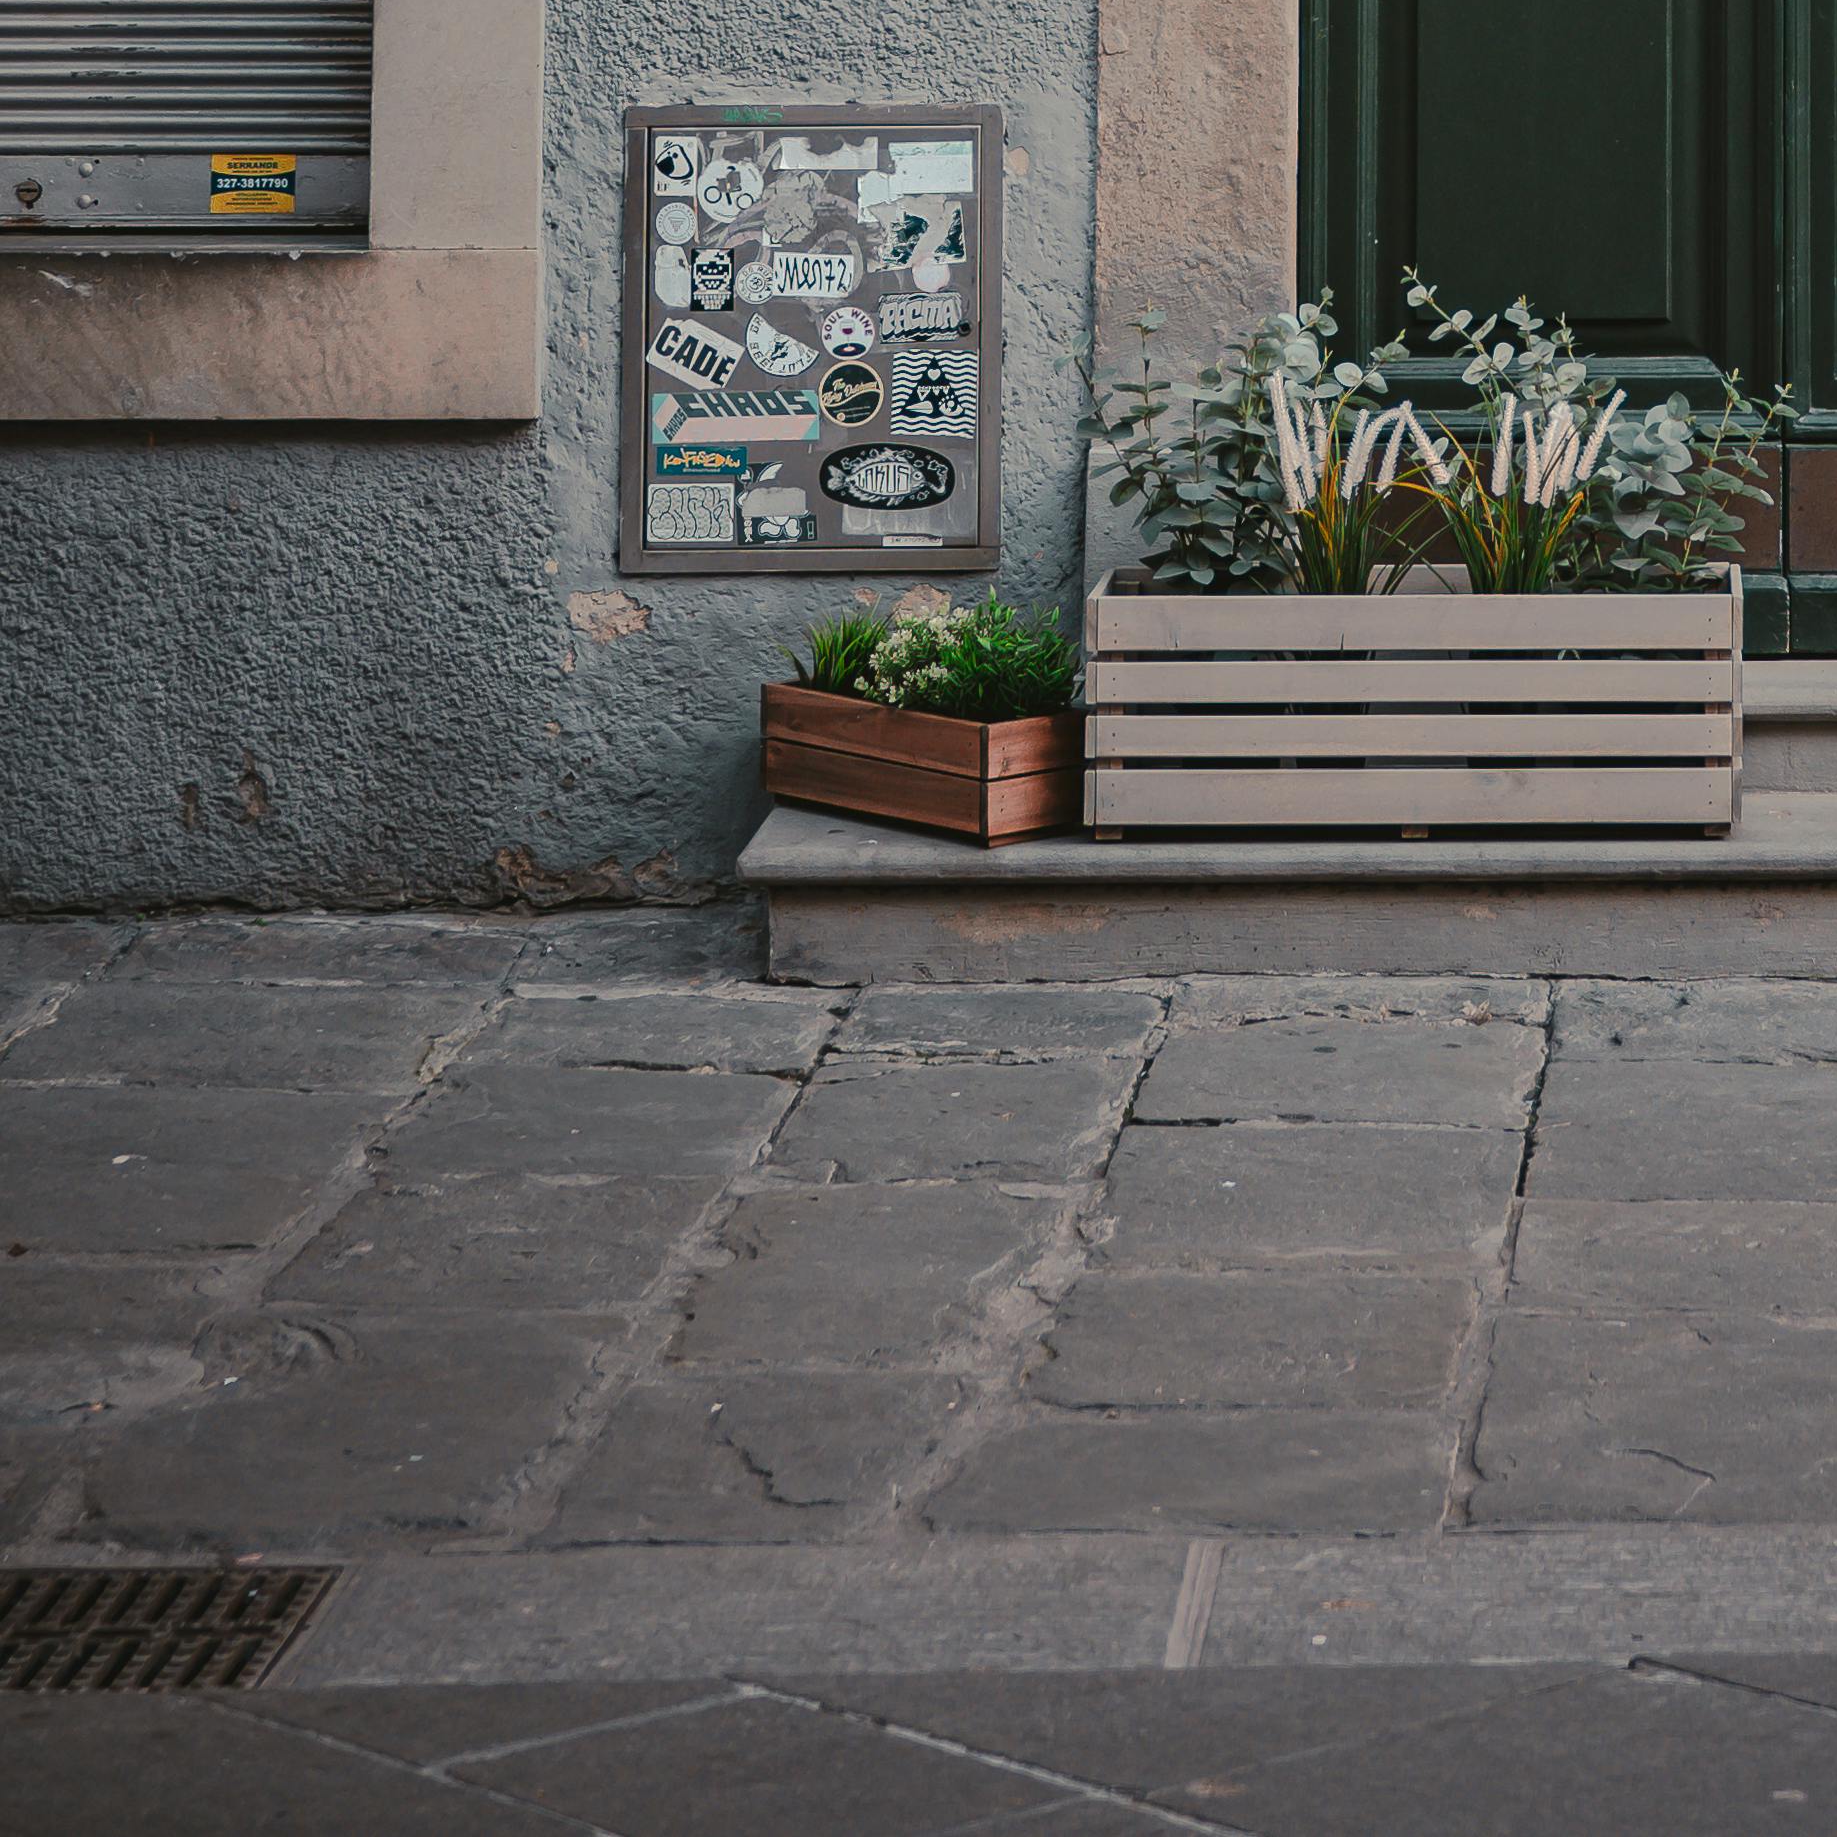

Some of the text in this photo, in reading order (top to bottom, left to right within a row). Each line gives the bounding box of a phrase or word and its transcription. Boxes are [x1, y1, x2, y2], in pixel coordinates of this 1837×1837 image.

[217, 178, 288, 188] 327-3817790
[824, 309, 873, 341] SOUL WINE
[655, 325, 736, 388] CADE
[671, 391, 818, 418] CHAOS
